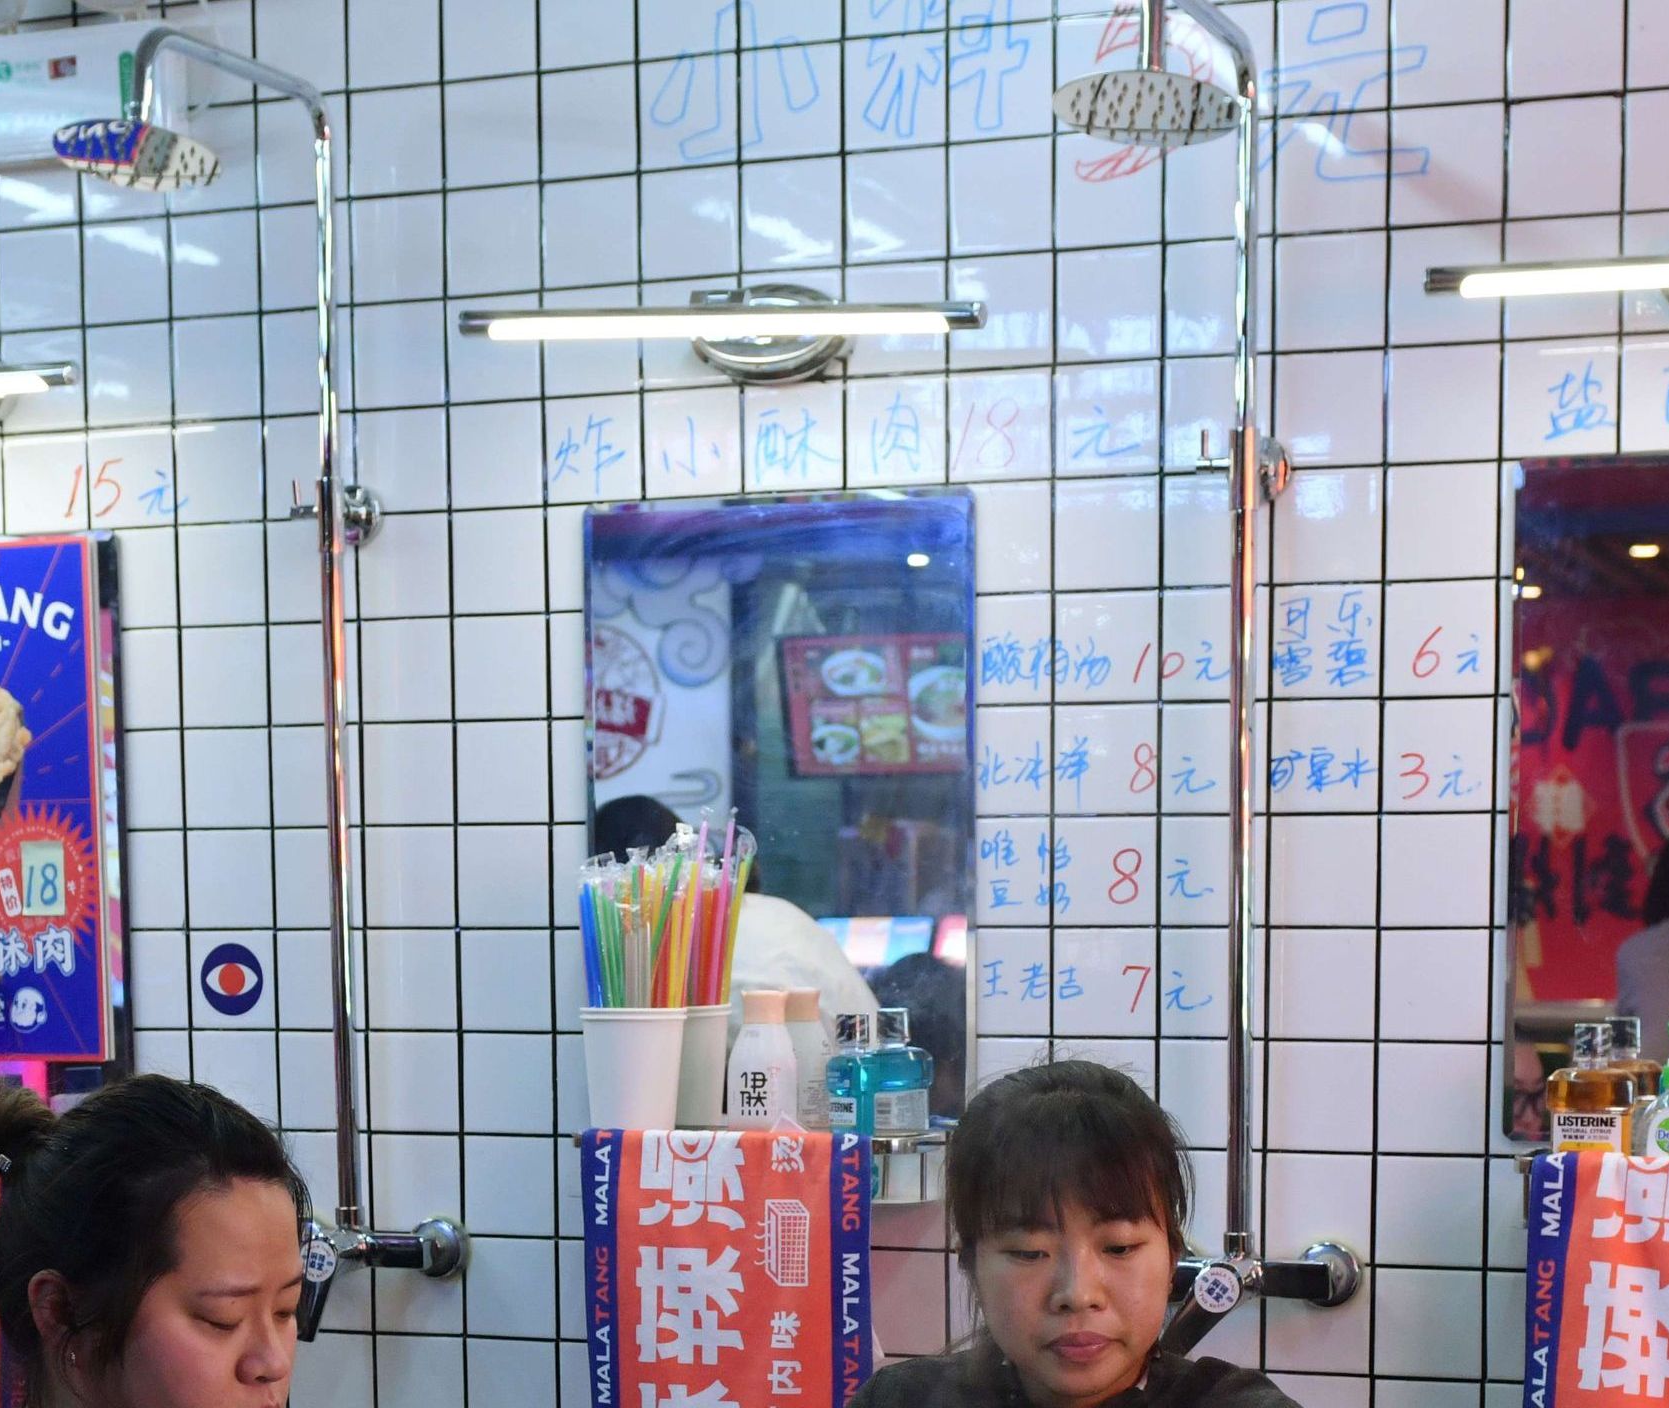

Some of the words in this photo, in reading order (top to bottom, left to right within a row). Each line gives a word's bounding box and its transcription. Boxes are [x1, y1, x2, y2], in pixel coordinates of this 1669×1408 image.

[552, 391, 922, 494] 炸小酥肉
[1279, 590, 1374, 640] 可乐
[981, 632, 1111, 688] 酸梅汤
[1270, 640, 1371, 690] 雪碧
[25, 863, 58, 909] 18
[983, 962, 1086, 1002] 王老吉
[1557, 1115, 1617, 1128] LISTERINE
